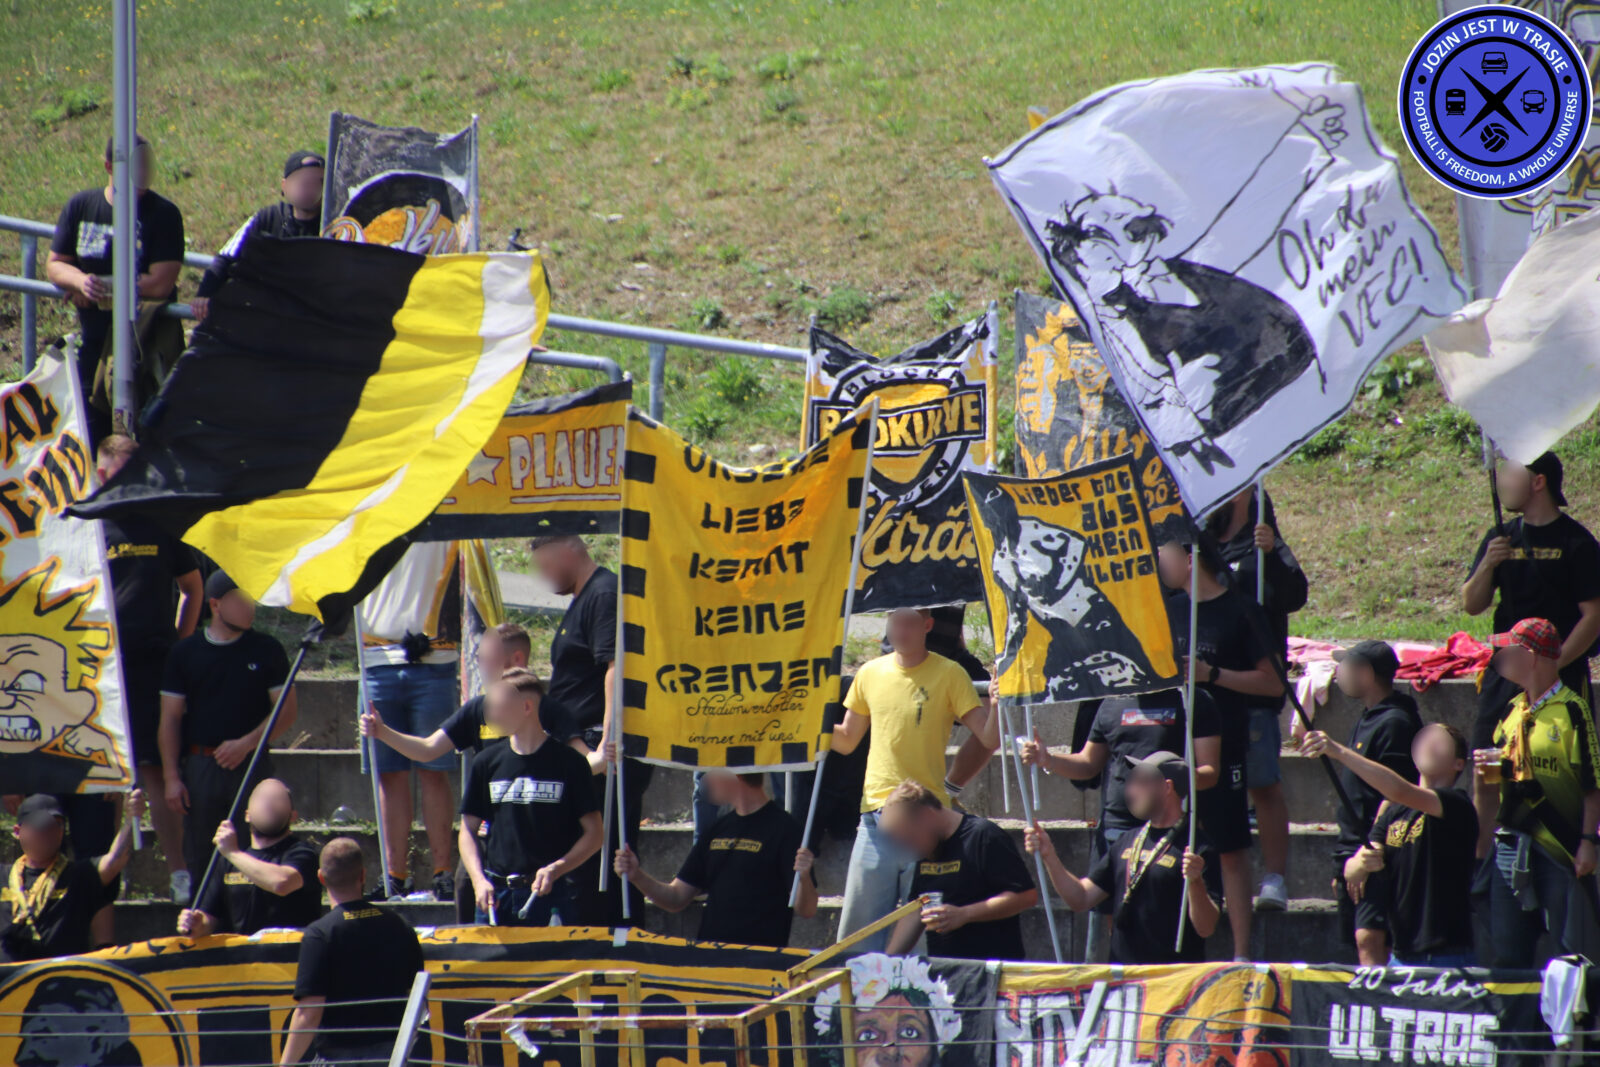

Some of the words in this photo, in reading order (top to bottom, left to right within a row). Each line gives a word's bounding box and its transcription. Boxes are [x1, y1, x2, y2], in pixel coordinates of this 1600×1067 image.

[1278, 219, 1335, 290] Oh
[1319, 220, 1396, 308] mein
[0, 383, 61, 469] AL
[1090, 470, 1131, 497] tot
[701, 497, 806, 533] LIEBE
[689, 541, 810, 583] KENNT
[695, 600, 805, 637] KEINE
[656, 657, 831, 694] GRENZEN
[688, 732, 735, 745] immer
[740, 719, 780, 742] mit
[769, 723, 801, 741] uns!
[1349, 966, 1387, 989] 20
[1391, 968, 1489, 999] Jahre
[1329, 1003, 1500, 1066] ULTRAS
